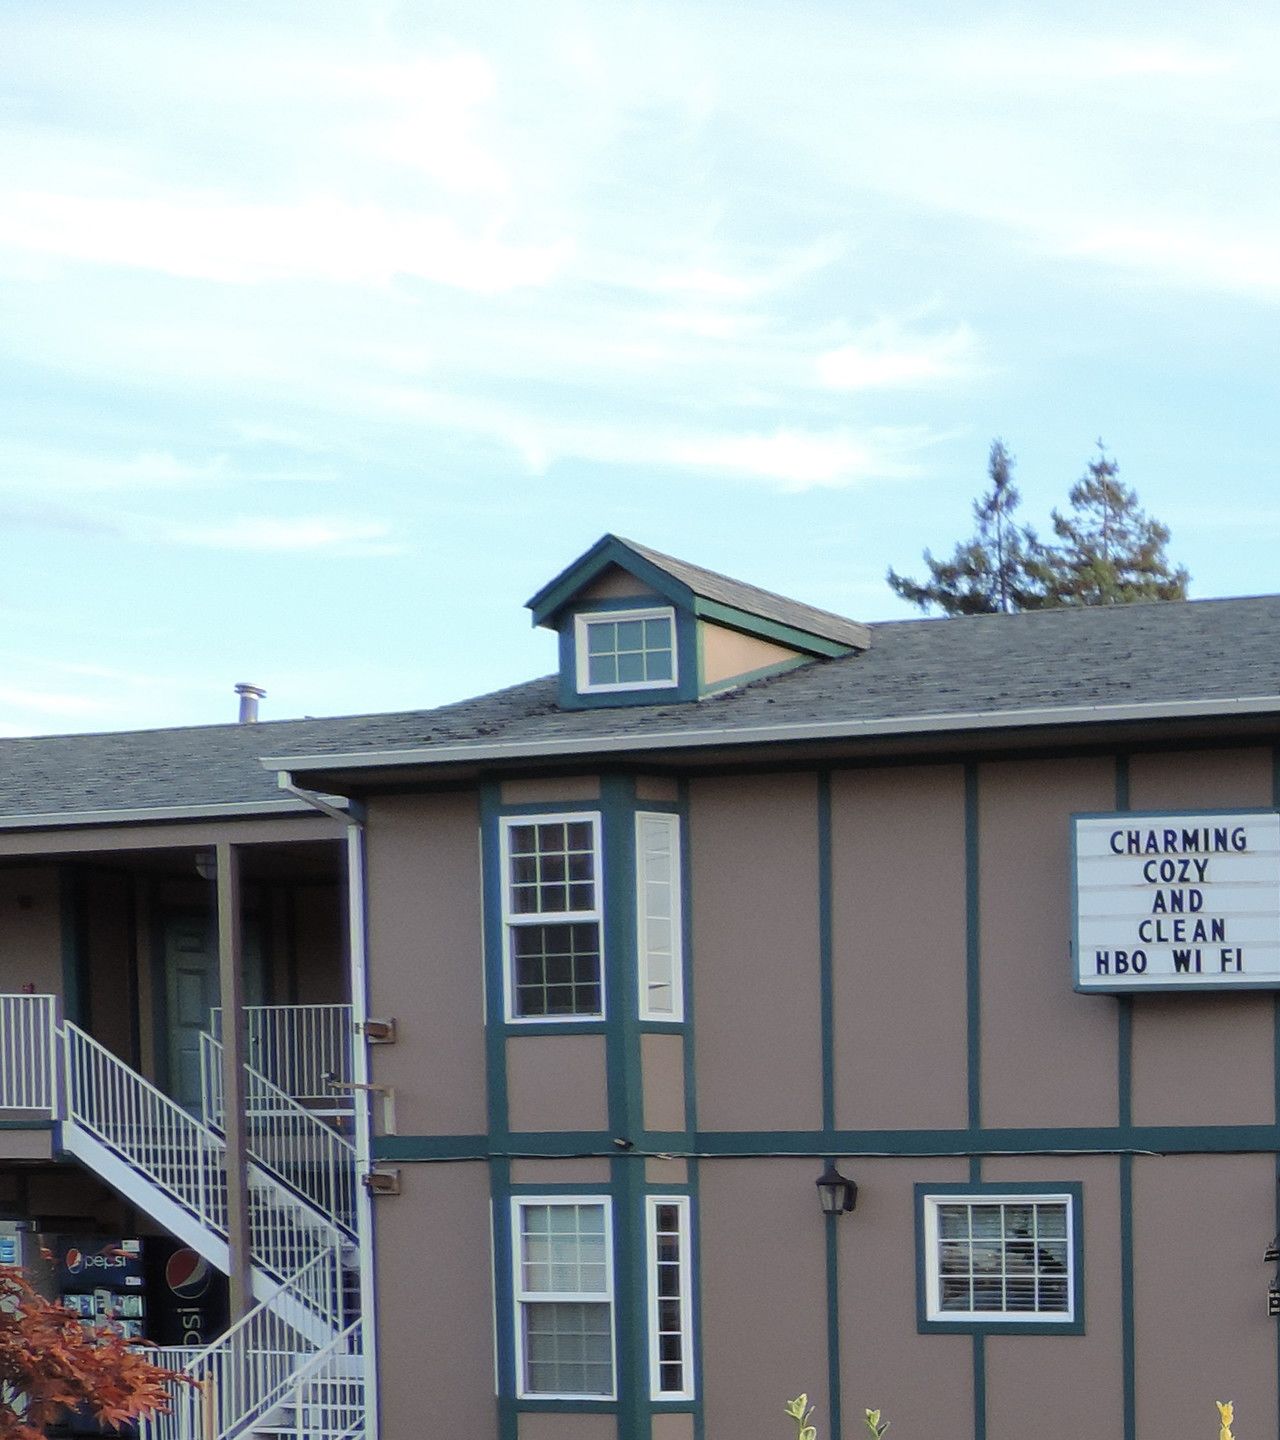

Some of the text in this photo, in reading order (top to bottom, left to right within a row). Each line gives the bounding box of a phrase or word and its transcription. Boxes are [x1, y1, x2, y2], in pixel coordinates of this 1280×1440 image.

[1110, 827, 1247, 854] CHARMING
[1143, 859, 1209, 883] COZY
[1152, 889, 1203, 913] AND
[1138, 918, 1226, 943] CLEAN
[1096, 948, 1243, 975] HBO WI FI
[83, 1254, 127, 1270] pepsi
